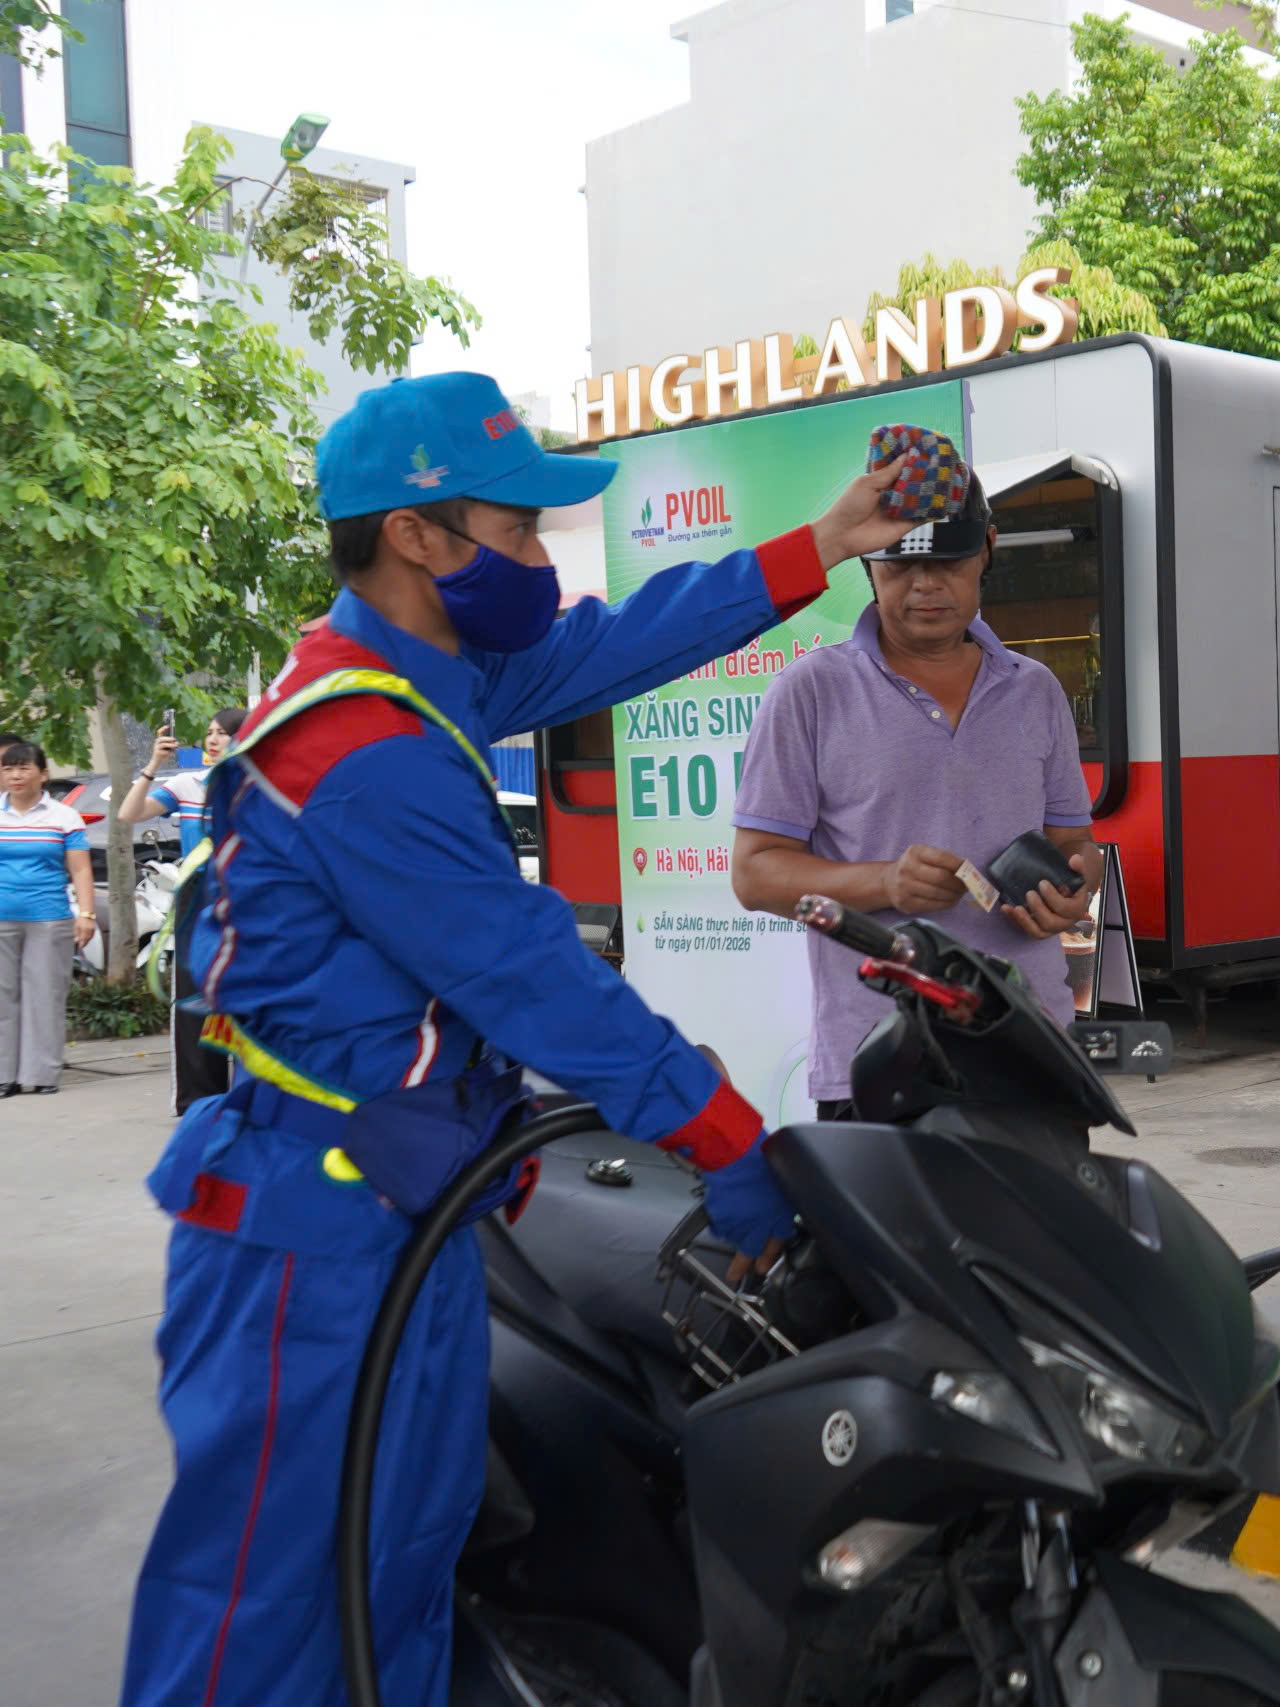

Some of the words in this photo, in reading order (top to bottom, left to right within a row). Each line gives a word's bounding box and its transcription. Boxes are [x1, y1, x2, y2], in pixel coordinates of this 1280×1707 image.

[574, 266, 1078, 443] HIGHLANDS
[666, 484, 732, 530] PVOIL
[632, 526, 664, 540] PETROVIETNAM
[641, 538, 656, 548] PVOIL
[626, 694, 699, 740] XĂNG
[708, 695, 761, 736] SIN
[630, 754, 718, 817] E10
[656, 847, 673, 871] Hà
[678, 848, 703, 878] Nội,
[707, 846, 729, 872] Hải
[677, 914, 703, 931] SÀNG
[694, 936, 750, 951] 01/01/2026
